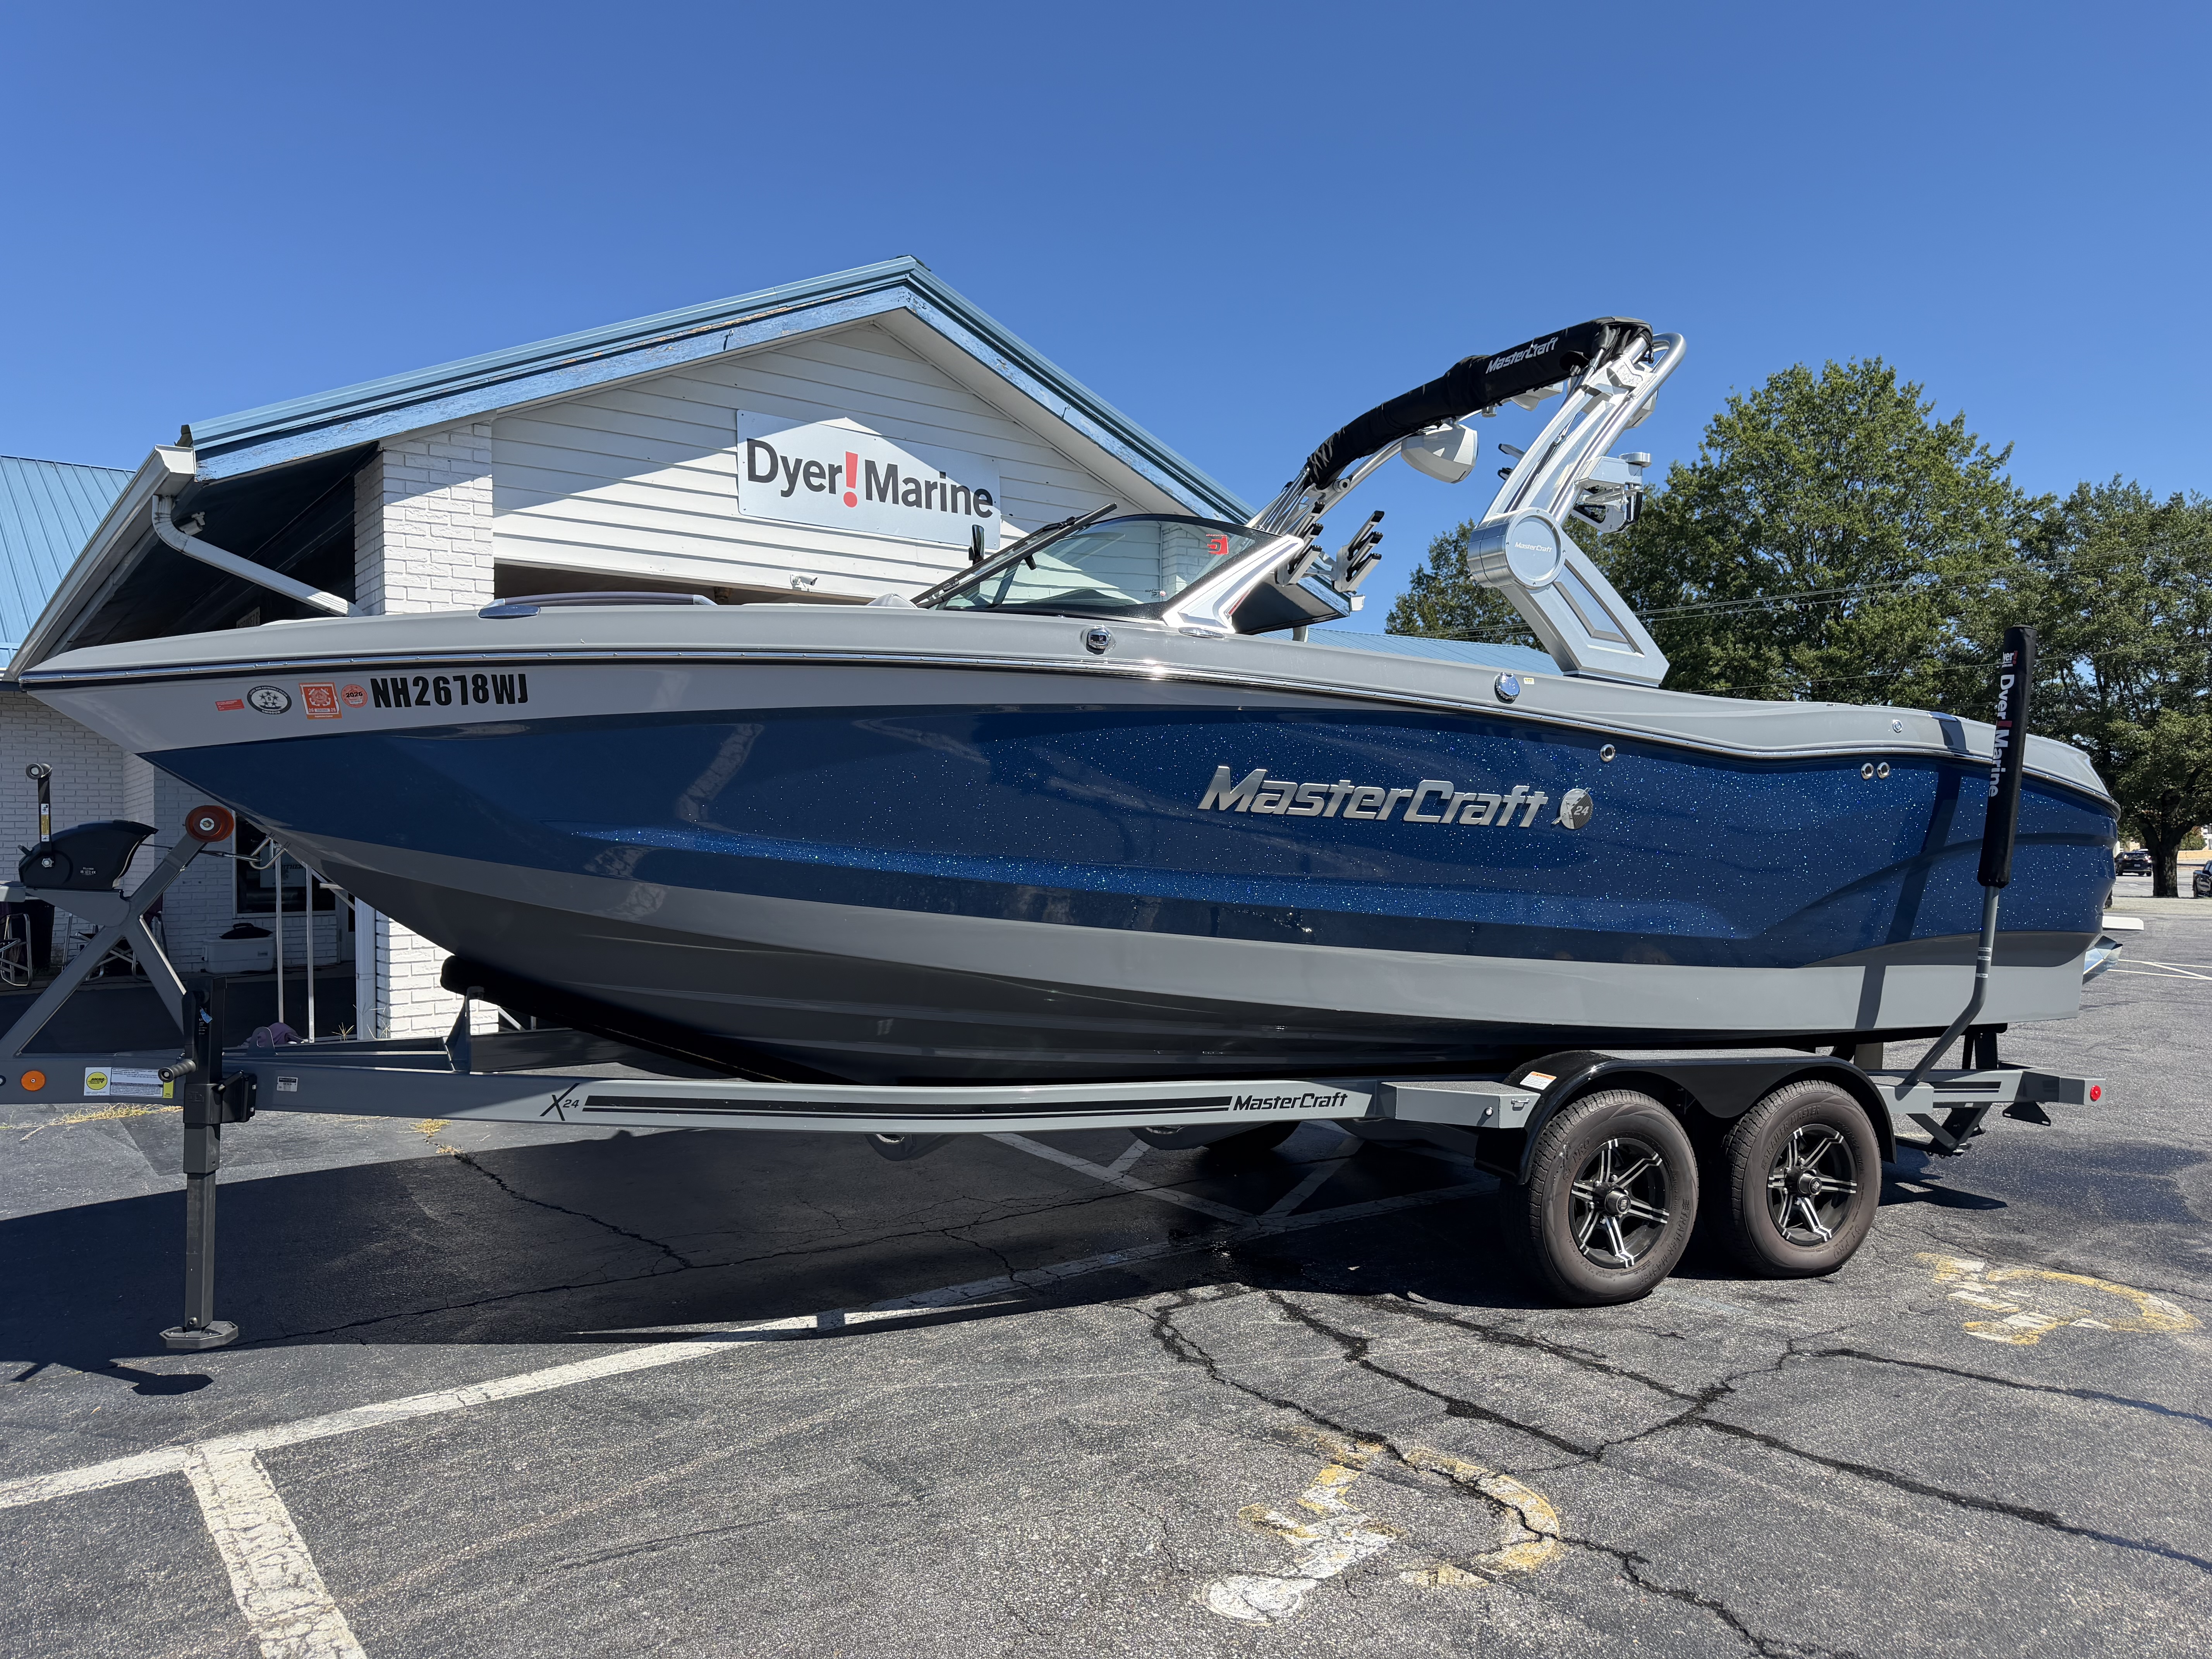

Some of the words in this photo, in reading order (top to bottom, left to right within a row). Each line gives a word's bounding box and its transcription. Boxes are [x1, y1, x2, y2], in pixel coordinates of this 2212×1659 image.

[1486, 337, 1559, 374] MasterCraft
[1515, 542, 1552, 552] MasterCraft
[1197, 765, 1549, 827] MasterCraft
[1233, 1092, 1348, 1111] MasterCraft
